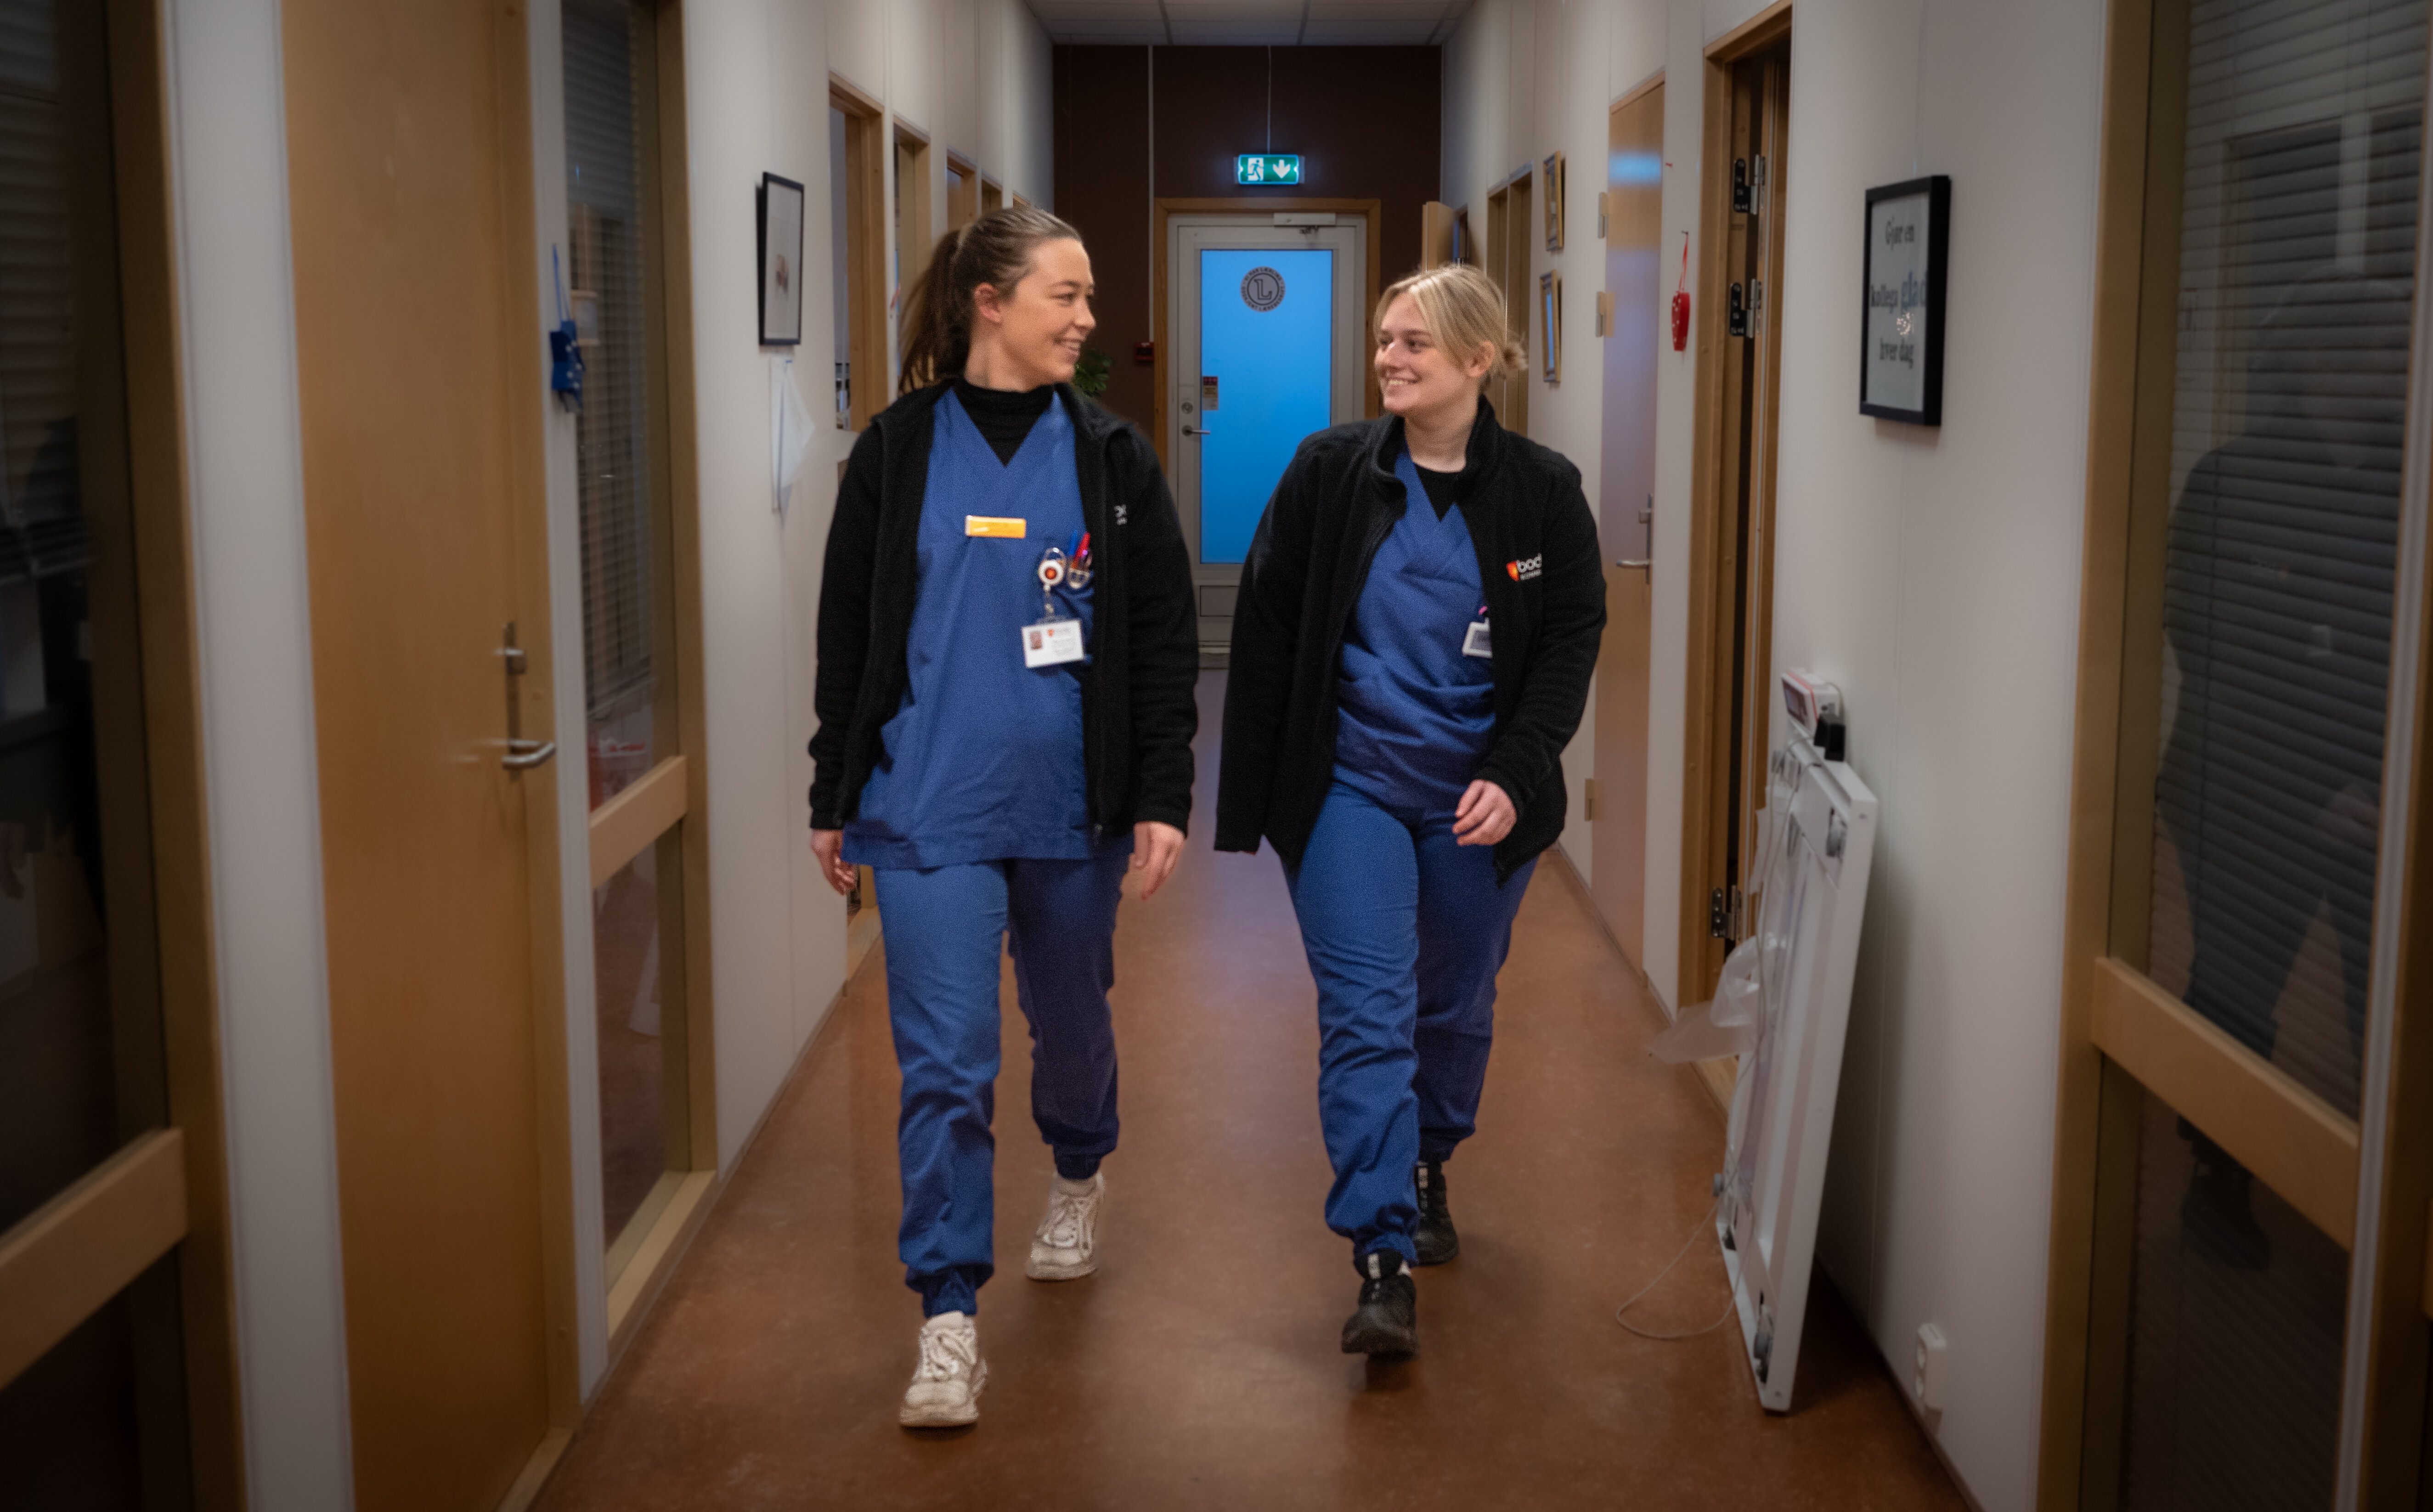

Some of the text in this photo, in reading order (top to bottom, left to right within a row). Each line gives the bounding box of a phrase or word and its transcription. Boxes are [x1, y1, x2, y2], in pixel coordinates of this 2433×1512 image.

[1904, 224, 1915, 243] en
[1254, 278, 1273, 300] L
[1880, 336, 1914, 369] hver dag
[1516, 553, 1542, 573] bod
